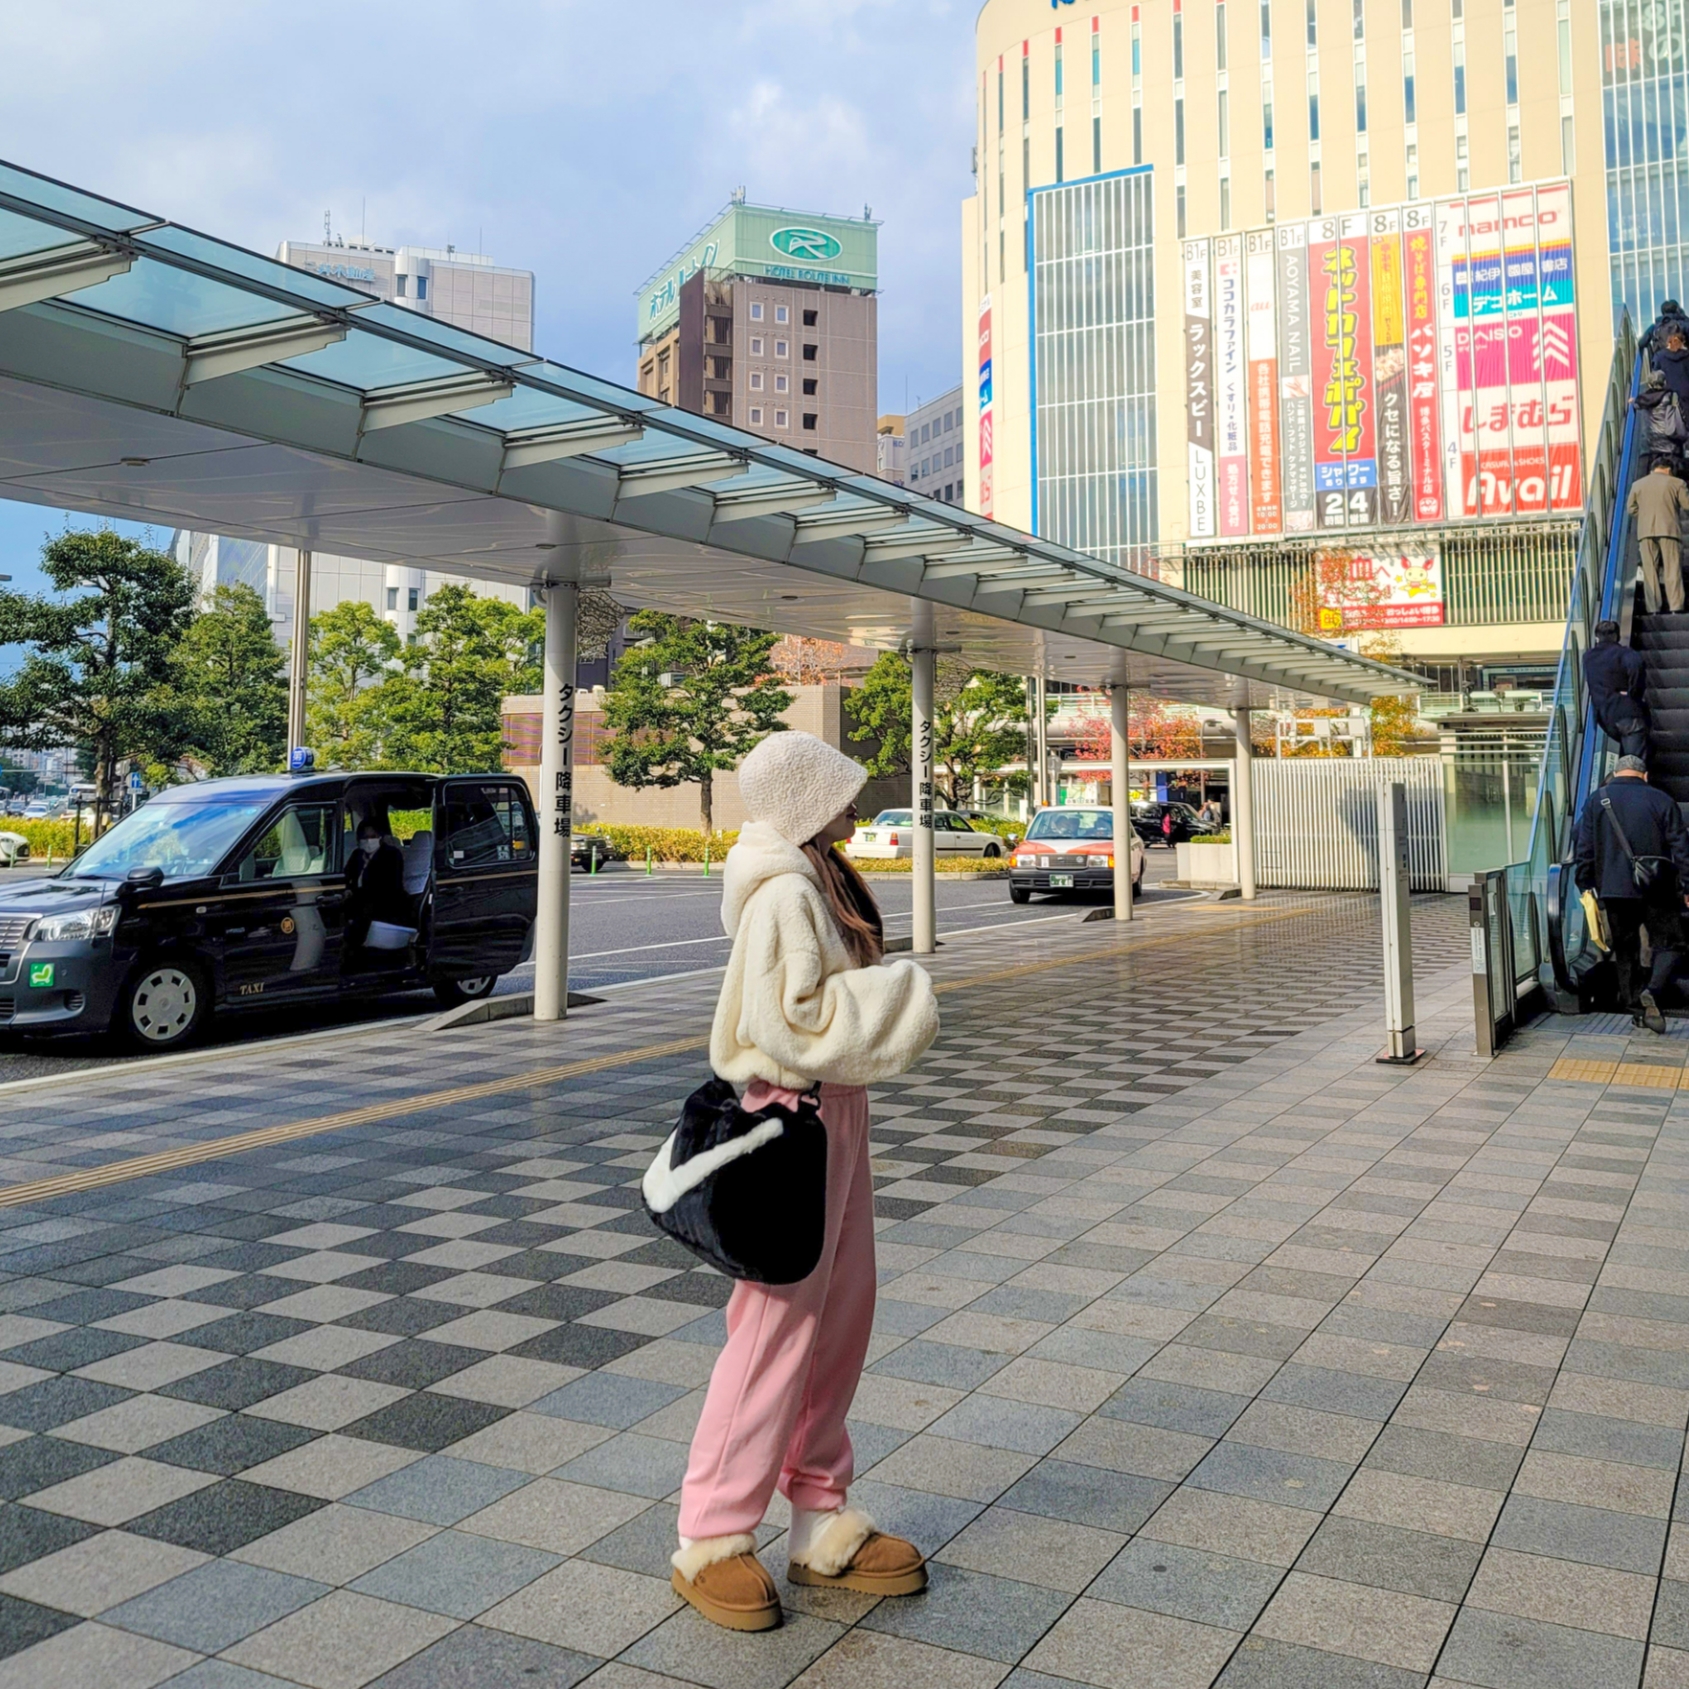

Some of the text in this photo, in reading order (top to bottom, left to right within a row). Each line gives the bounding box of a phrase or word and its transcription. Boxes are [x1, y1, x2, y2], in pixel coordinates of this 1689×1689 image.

[1322, 218, 1352, 240] 8F
[1374, 214, 1397, 233] 8F
[1406, 209, 1430, 228] 8F
[1458, 210, 1558, 238] namco
[1217, 238, 1239, 257] B1F
[1249, 233, 1272, 253] B1F
[1280, 228, 1304, 247] B1F
[1186, 242, 1207, 262] B1F
[764, 266, 850, 285] HOTEL ROUTE INN
[1190, 269, 1203, 309] 美容室
[1250, 301, 1271, 313] au
[1285, 254, 1302, 373] AOYAMA NAIL
[1473, 285, 1558, 314] デコホーム
[1223, 278, 1237, 374] ココカラファイン
[1457, 325, 1523, 345] DAISO
[1323, 246, 1364, 453] ネットカフェポパイ
[1188, 323, 1208, 437] ラックスビー
[1462, 395, 1575, 434] しまむら
[1420, 406, 1433, 494] 博多バスターミナル店
[1195, 449, 1206, 532] LUXBE
[1466, 464, 1573, 507] Avail
[1325, 491, 1368, 515] 24
[553, 683, 574, 839] タクシー降車場
[918, 720, 933, 829] タクシー降車場
[240, 982, 265, 996] TAXI
